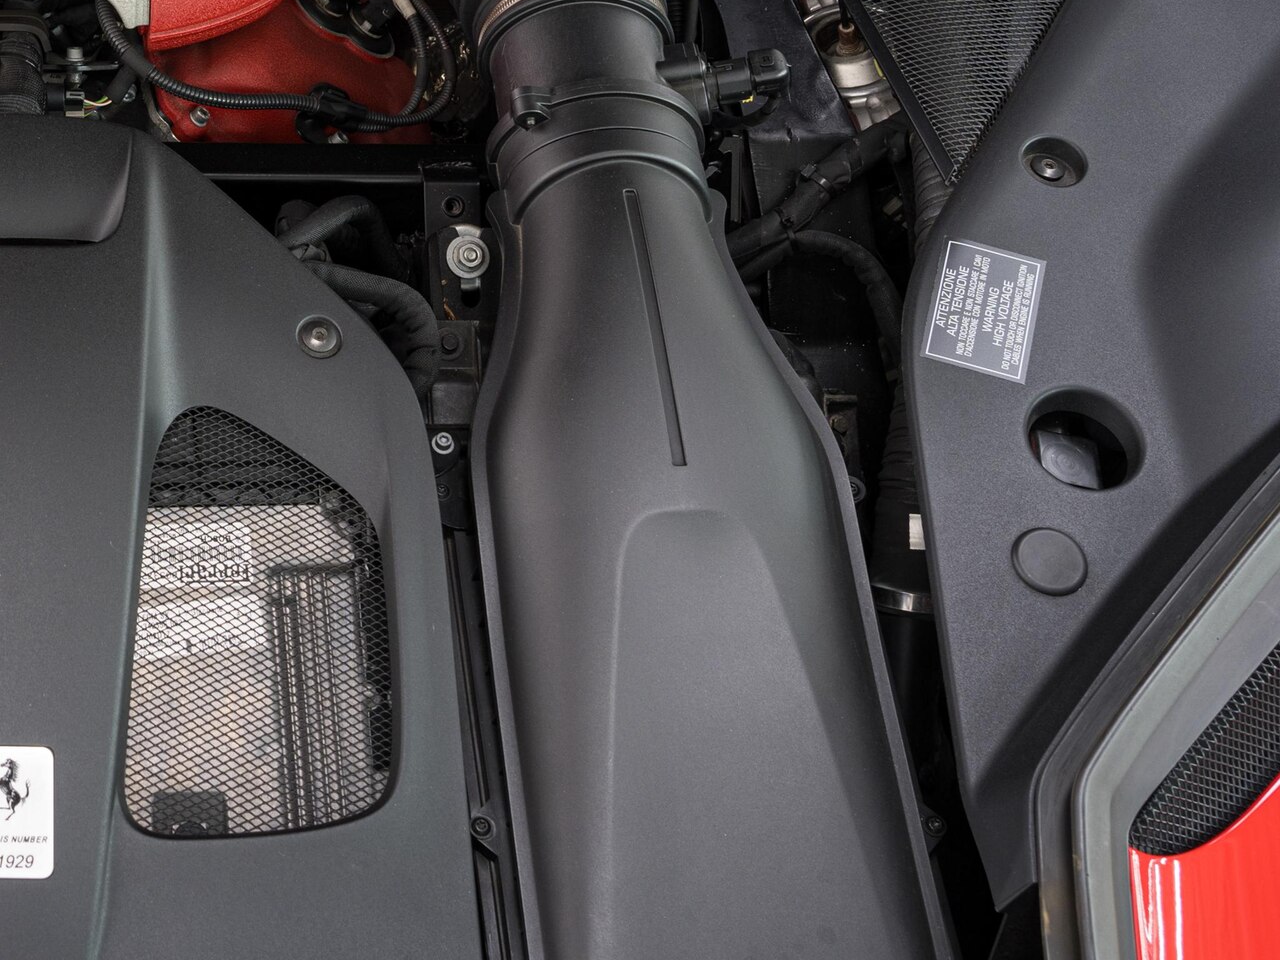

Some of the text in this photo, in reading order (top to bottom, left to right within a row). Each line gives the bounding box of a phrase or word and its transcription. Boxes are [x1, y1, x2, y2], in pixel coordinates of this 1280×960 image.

[981, 257, 990, 273] MOTO
[968, 271, 979, 297] STACCARE
[975, 281, 985, 304] MOTORE
[1024, 274, 1034, 298] RUNNING
[936, 268, 956, 327] ATTENZIONE
[947, 266, 969, 336] ALTA TENSIONE
[965, 298, 973, 310] NON
[1011, 288, 1022, 321] DISCONNECT
[972, 305, 980, 317] CON
[982, 287, 999, 331] WARNING
[992, 280, 1013, 346] HIGH VOLTAGE
[1019, 306, 1028, 325] ENGINE
[959, 317, 970, 340] TOCCARE
[1016, 327, 1024, 343] WHEN
[956, 342, 964, 355] NON
[1005, 330, 1015, 348] TOUCH
[1003, 349, 1011, 360] NOT
[1011, 345, 1021, 365] CABLES
[179, 563, 251, 583] Ferrari
